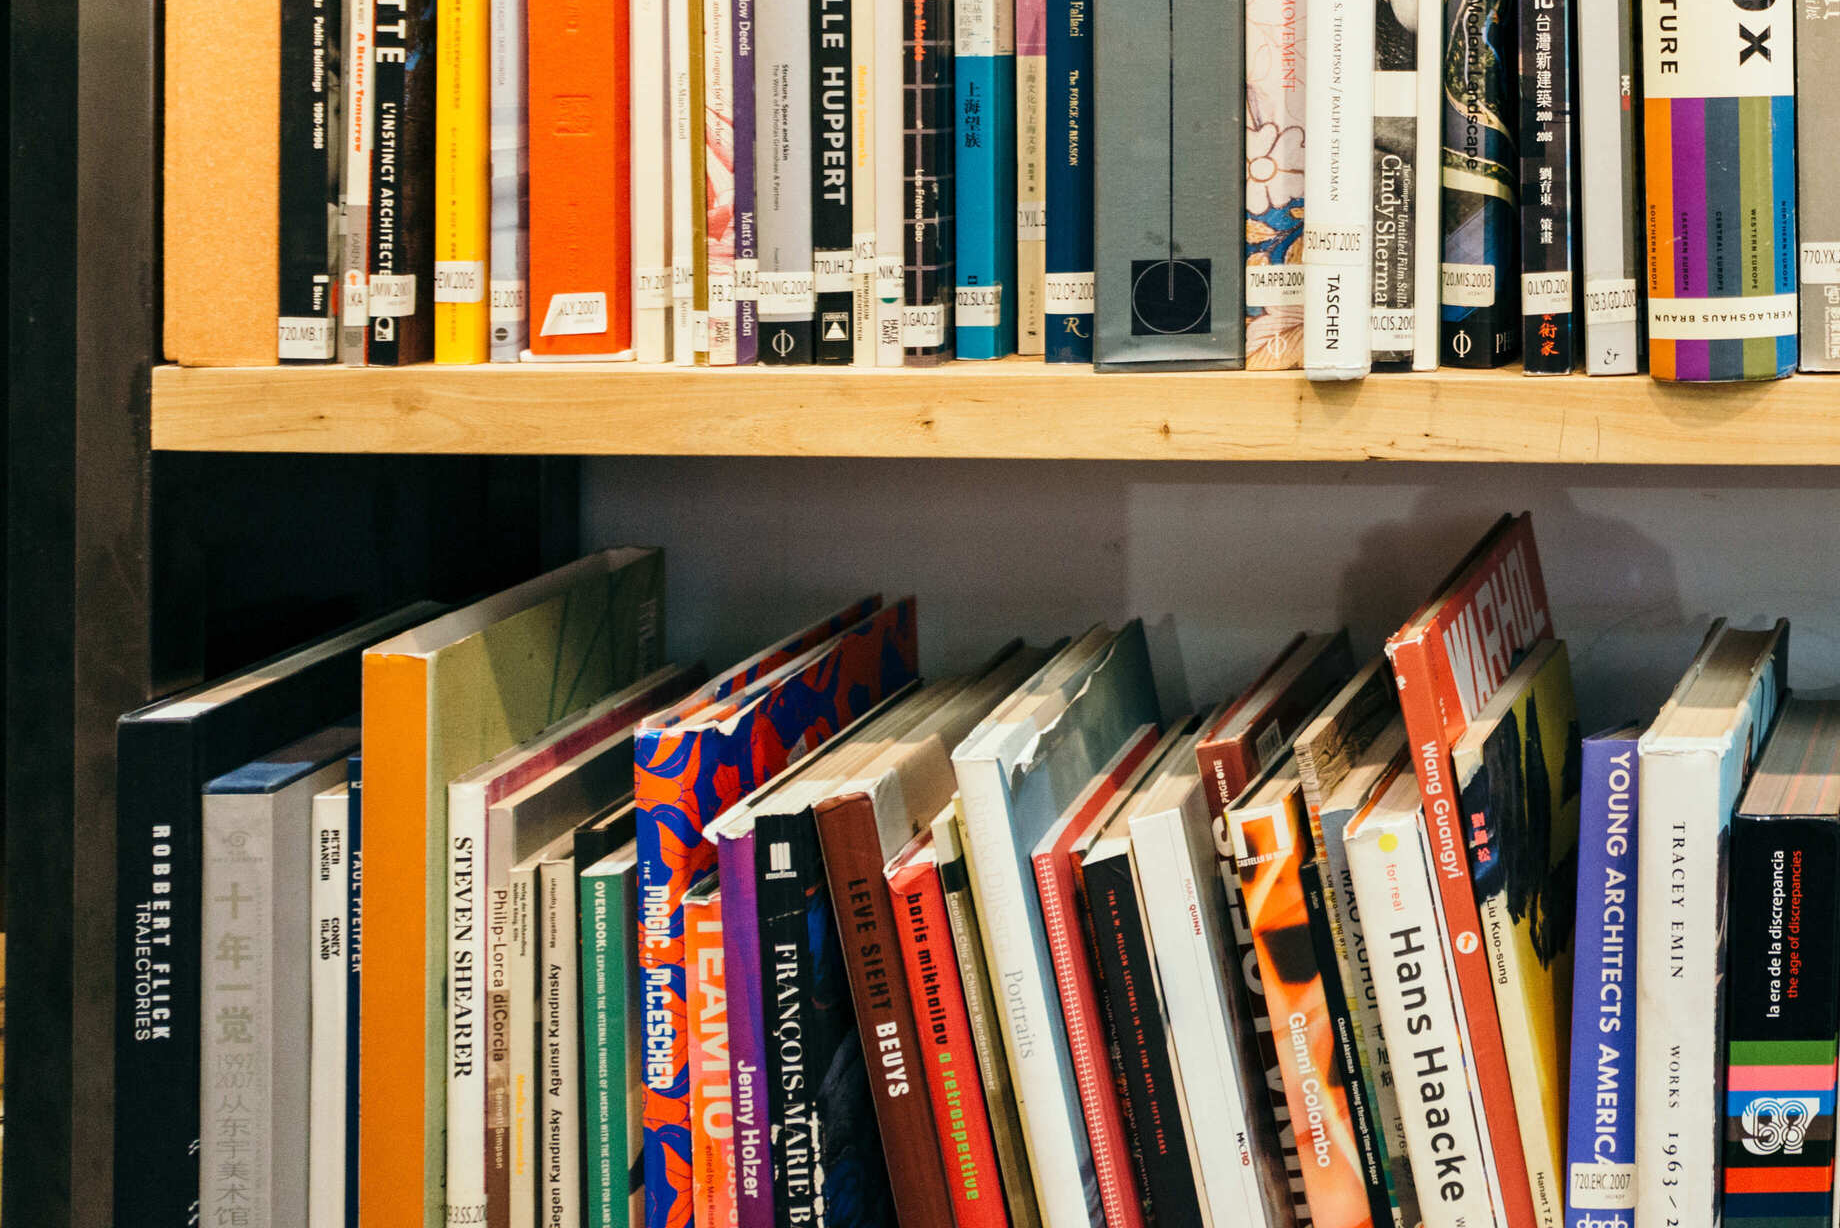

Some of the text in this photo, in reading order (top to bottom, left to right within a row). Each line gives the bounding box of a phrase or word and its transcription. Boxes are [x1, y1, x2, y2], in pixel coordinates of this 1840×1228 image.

[312, 46, 325, 93] Buildings
[313, 16, 325, 45] Public
[312, 101, 324, 149] 1990-1998
[822, 65, 846, 206] HUPPERT
[1324, 273, 1341, 351] TASCHEN
[1420, 739, 1463, 881] Wang Guangyi
[1603, 750, 1630, 858] YOUNG
[133, 900, 151, 1042] TRAJECTORIES
[151, 825, 171, 1040] ROBBERT FLICK
[451, 836, 473, 1080] STEVEN SHEARER
[1599, 867, 1626, 1034] ARCHITECTS
[1669, 821, 1686, 980] TRACEY EMIN
[490, 889, 510, 1063] Philip-Lorca diCorcia
[905, 891, 983, 1202] boris mikhailov a retrospective
[733, 1059, 762, 1198] Jenny Holzer
[1389, 925, 1468, 1204] Hans Haacke
